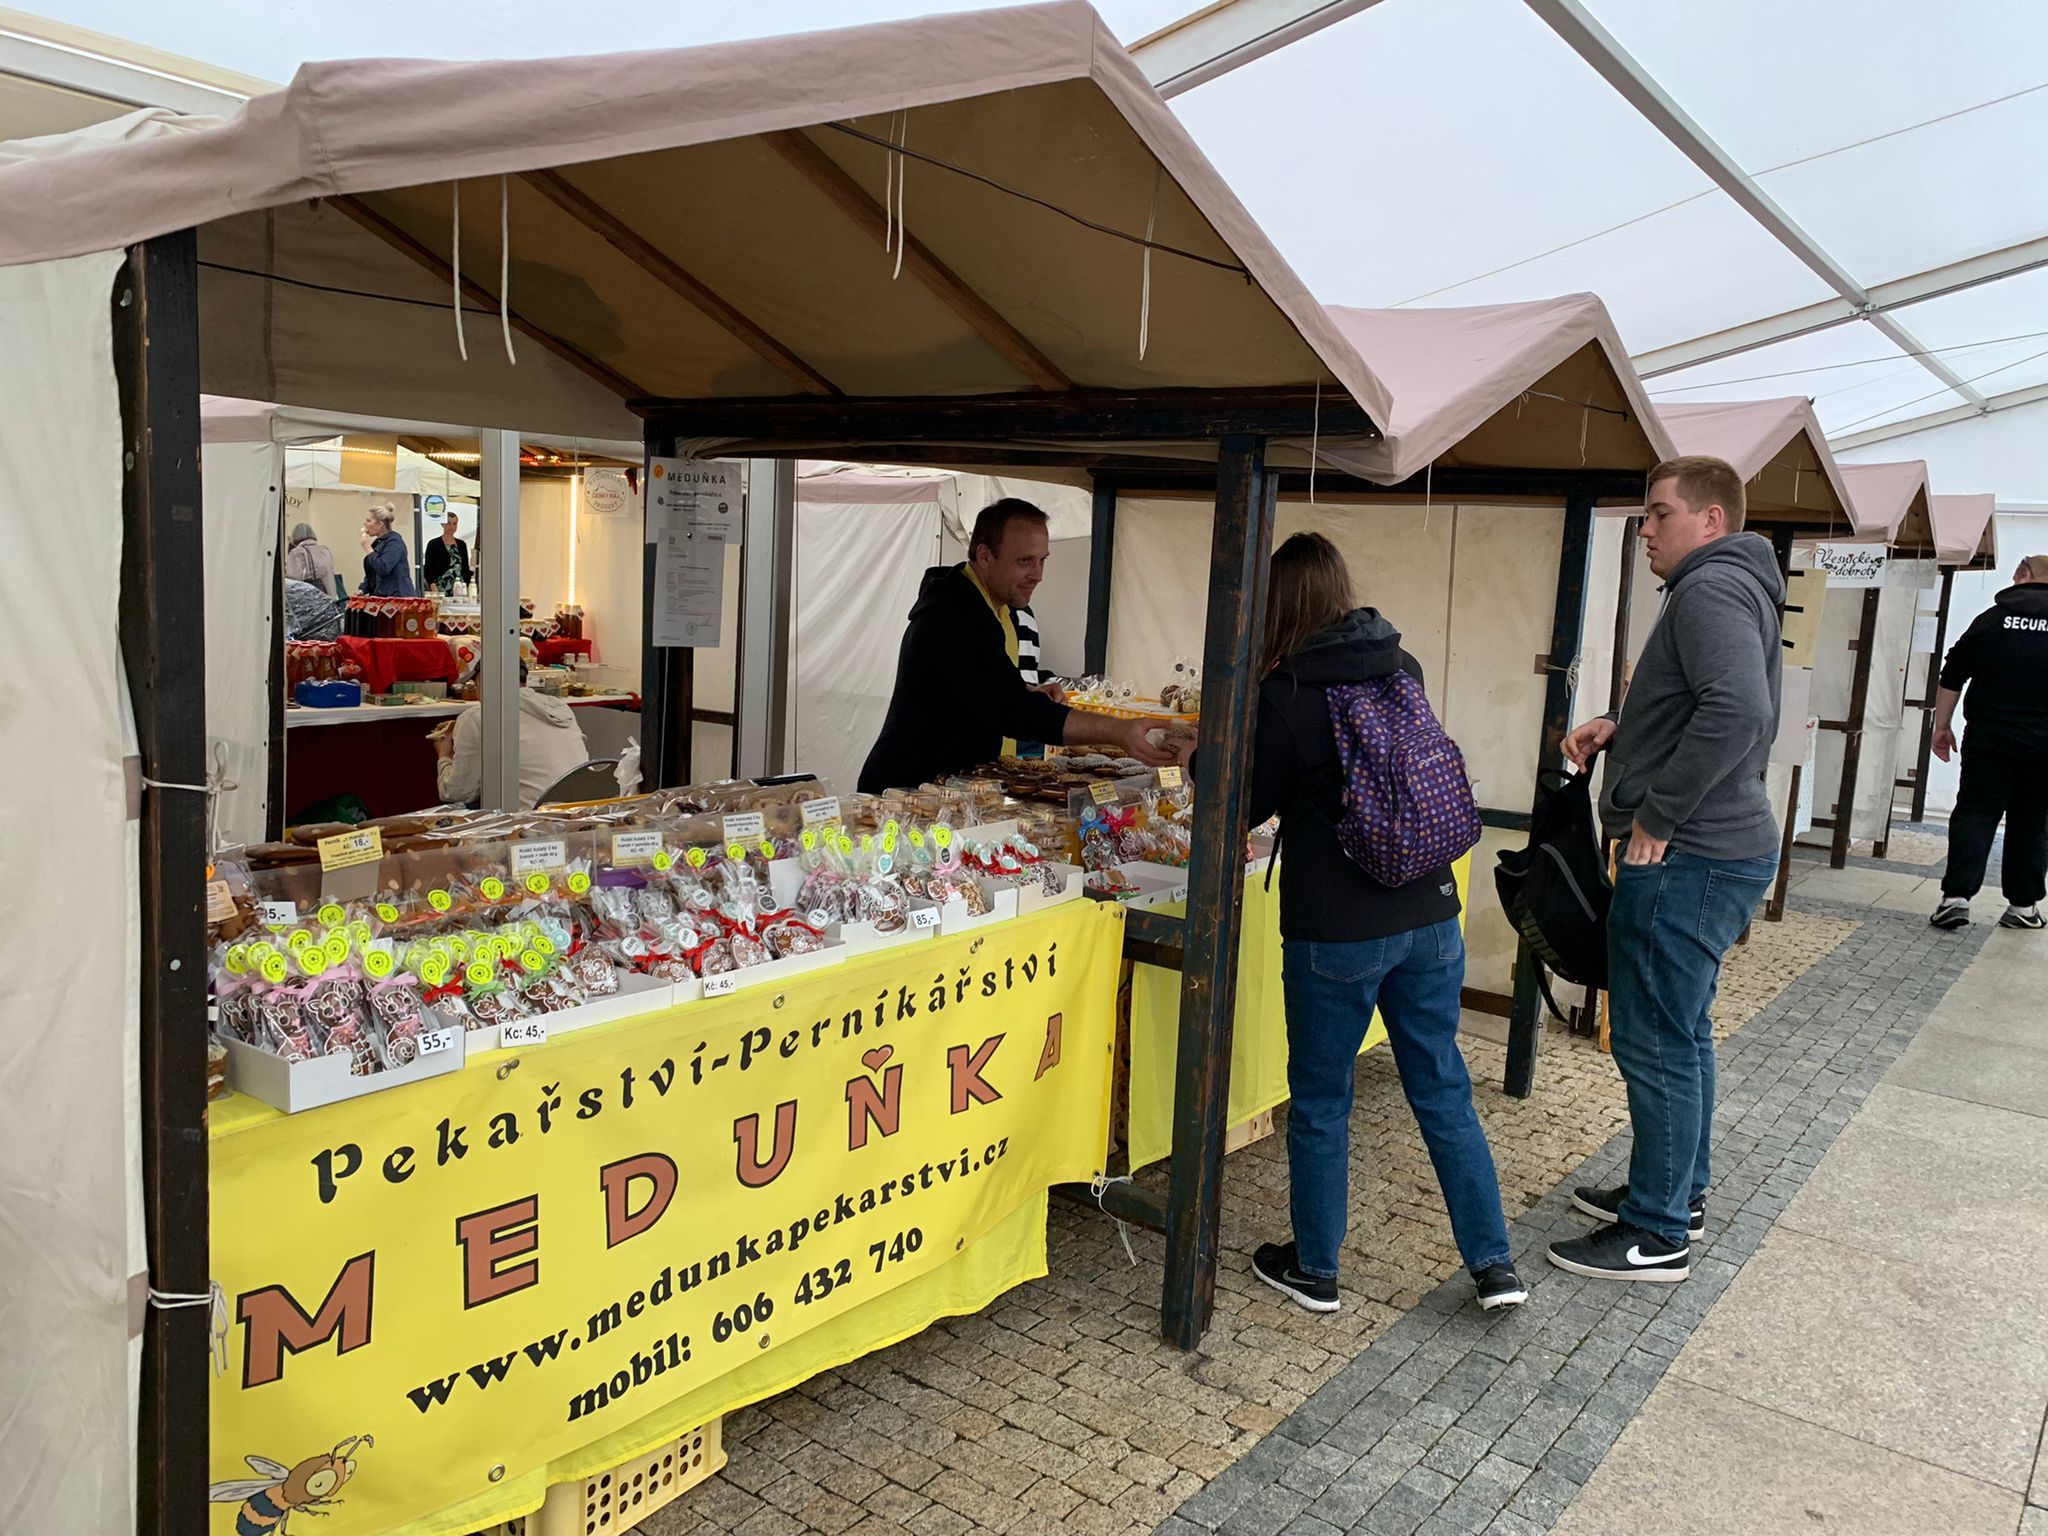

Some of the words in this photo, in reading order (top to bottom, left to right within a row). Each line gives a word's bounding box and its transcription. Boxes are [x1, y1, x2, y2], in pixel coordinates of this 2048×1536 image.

[667, 472, 726, 485] MEDUŇKA
[1816, 547, 1871, 565] Vesnické
[1835, 563, 1877, 579] dobroty
[2003, 616, 2048, 632] SECUR
[264, 908, 286, 921] 5,-
[916, 913, 934, 926] 85,-
[719, 979, 734, 990] 45,-
[505, 1027, 522, 1040] Kc:
[525, 1025, 545, 1039] 45,-
[422, 1033, 451, 1051] 55,-
[311, 942, 1059, 1204] Pekařství-Perníkářství
[237, 1012, 1064, 1389] MEDUŇKA
[406, 1136, 1009, 1415] www.medunkapekarstvi.cz
[568, 1333, 693, 1422] mobil:
[712, 1290, 774, 1345] 606
[794, 1258, 853, 1306] 432
[869, 1227, 923, 1274] 740
